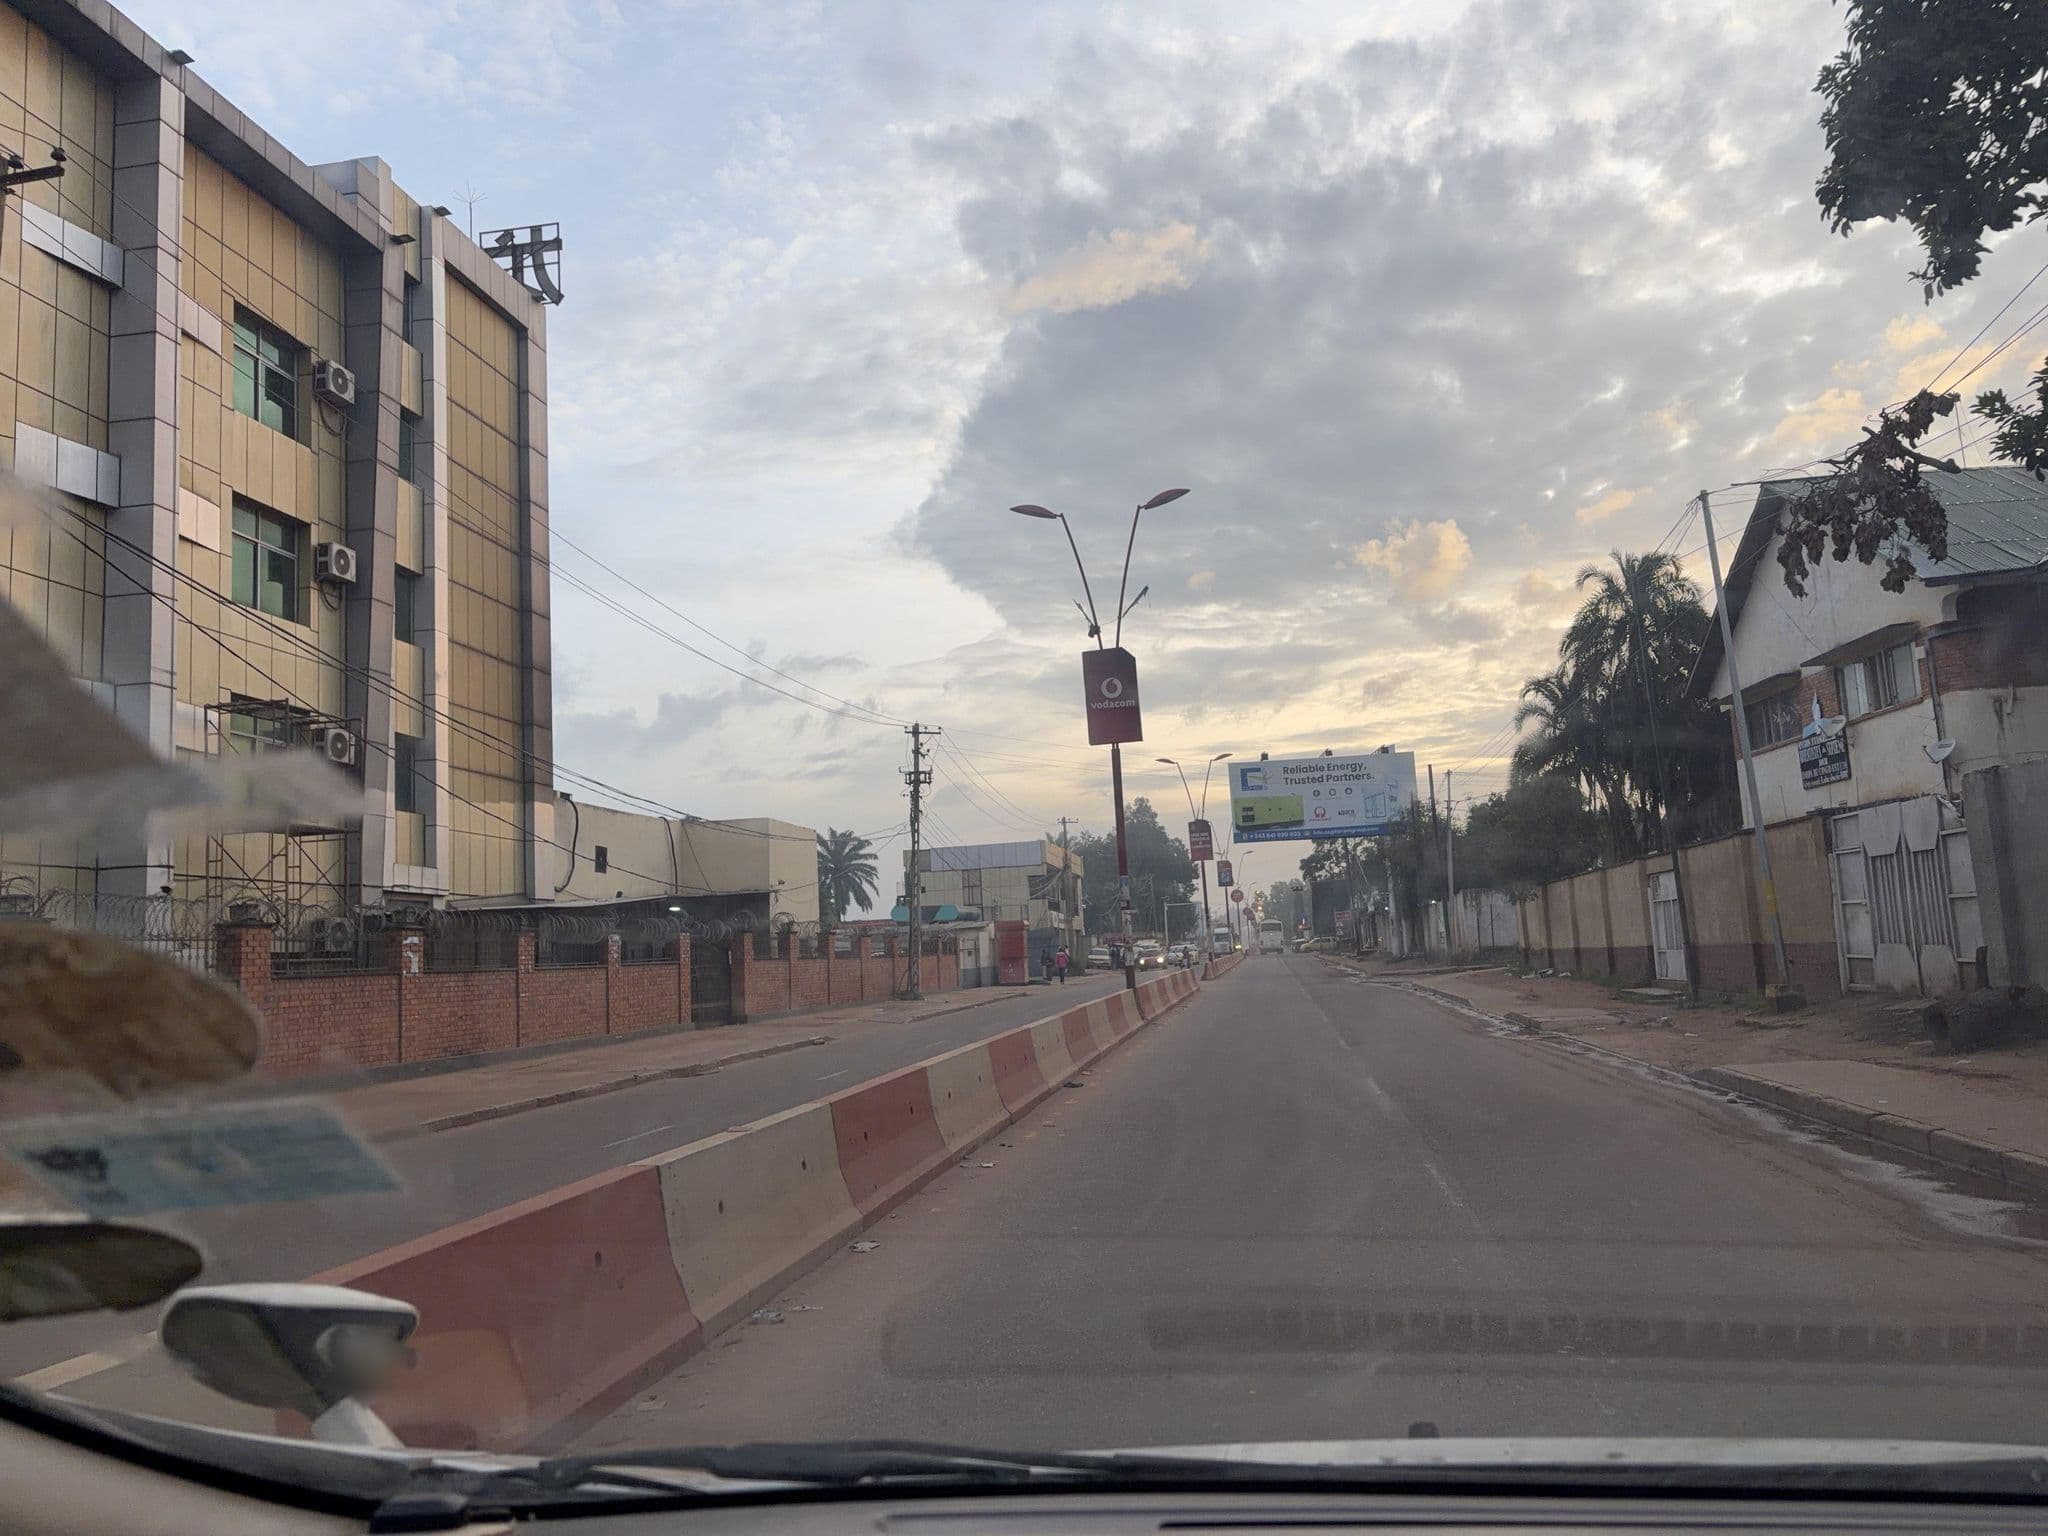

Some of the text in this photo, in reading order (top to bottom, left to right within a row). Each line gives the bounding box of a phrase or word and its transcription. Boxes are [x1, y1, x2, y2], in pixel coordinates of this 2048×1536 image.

[1091, 699, 1136, 709] vodacom
[1283, 761, 1367, 775] Reliable Energy,
[1283, 772, 1375, 785] Trusted Partners.
